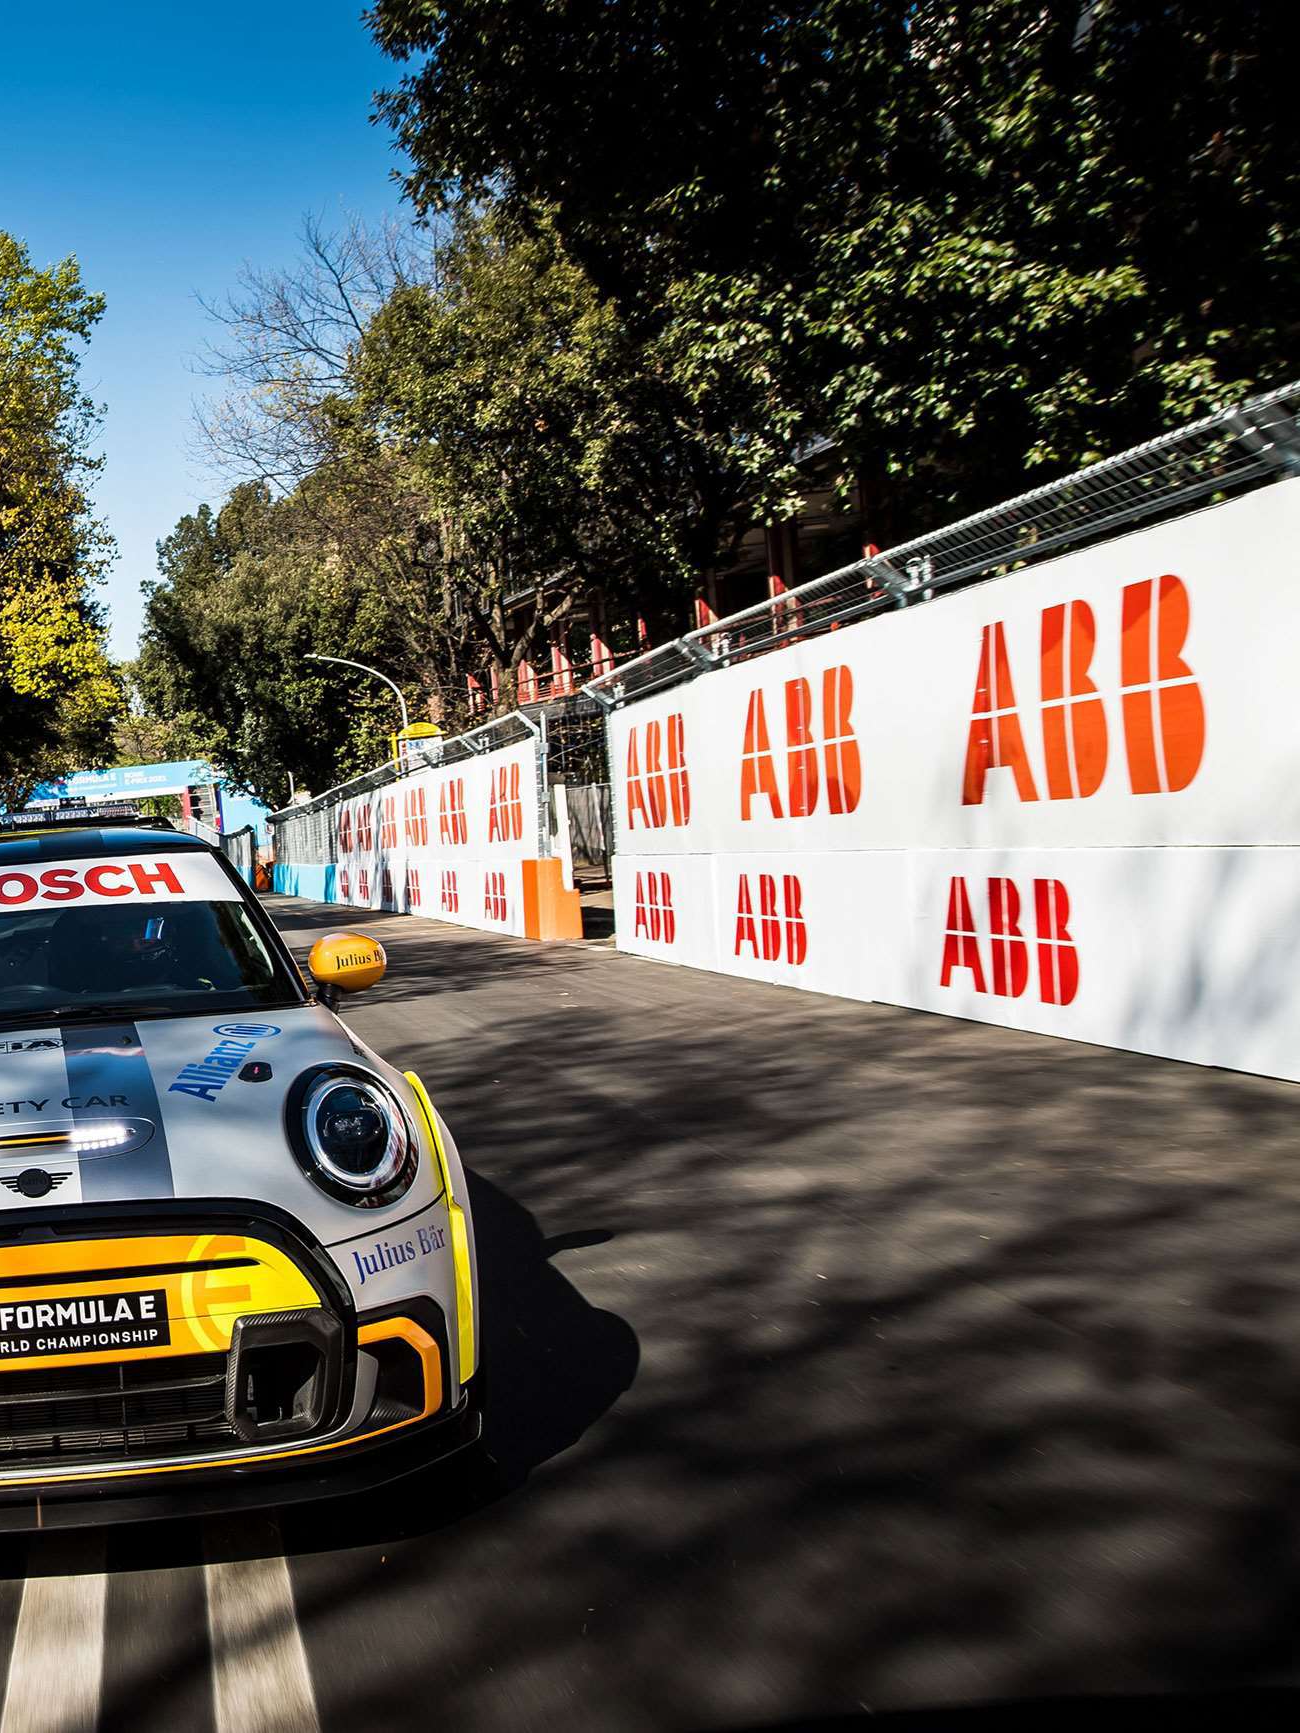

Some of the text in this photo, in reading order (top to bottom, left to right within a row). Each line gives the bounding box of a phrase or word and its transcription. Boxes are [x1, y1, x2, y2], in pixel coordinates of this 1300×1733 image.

[961, 573, 1208, 806] ABB
[626, 712, 691, 831] ABB
[740, 664, 863, 822] ABB
[404, 787, 428, 847] ABB
[439, 777, 468, 845] ABB
[489, 762, 523, 843] ABB
[441, 870, 459, 914] ABB
[484, 871, 507, 922] ABB
[635, 870, 675, 944] ABB
[735, 873, 808, 966] ABB
[336, 950, 372, 970] Julius
[939, 876, 1080, 1006] ABB
[61, 1094, 130, 1110] CAR
[168, 1039, 256, 1103] Allianz
[351, 1225, 445, 1285] Julius Bär
[0, 1297, 134, 1331] FORMULA
[140, 1295, 157, 1319] E
[36, 1328, 159, 1351] CHAMPIONSHIP
